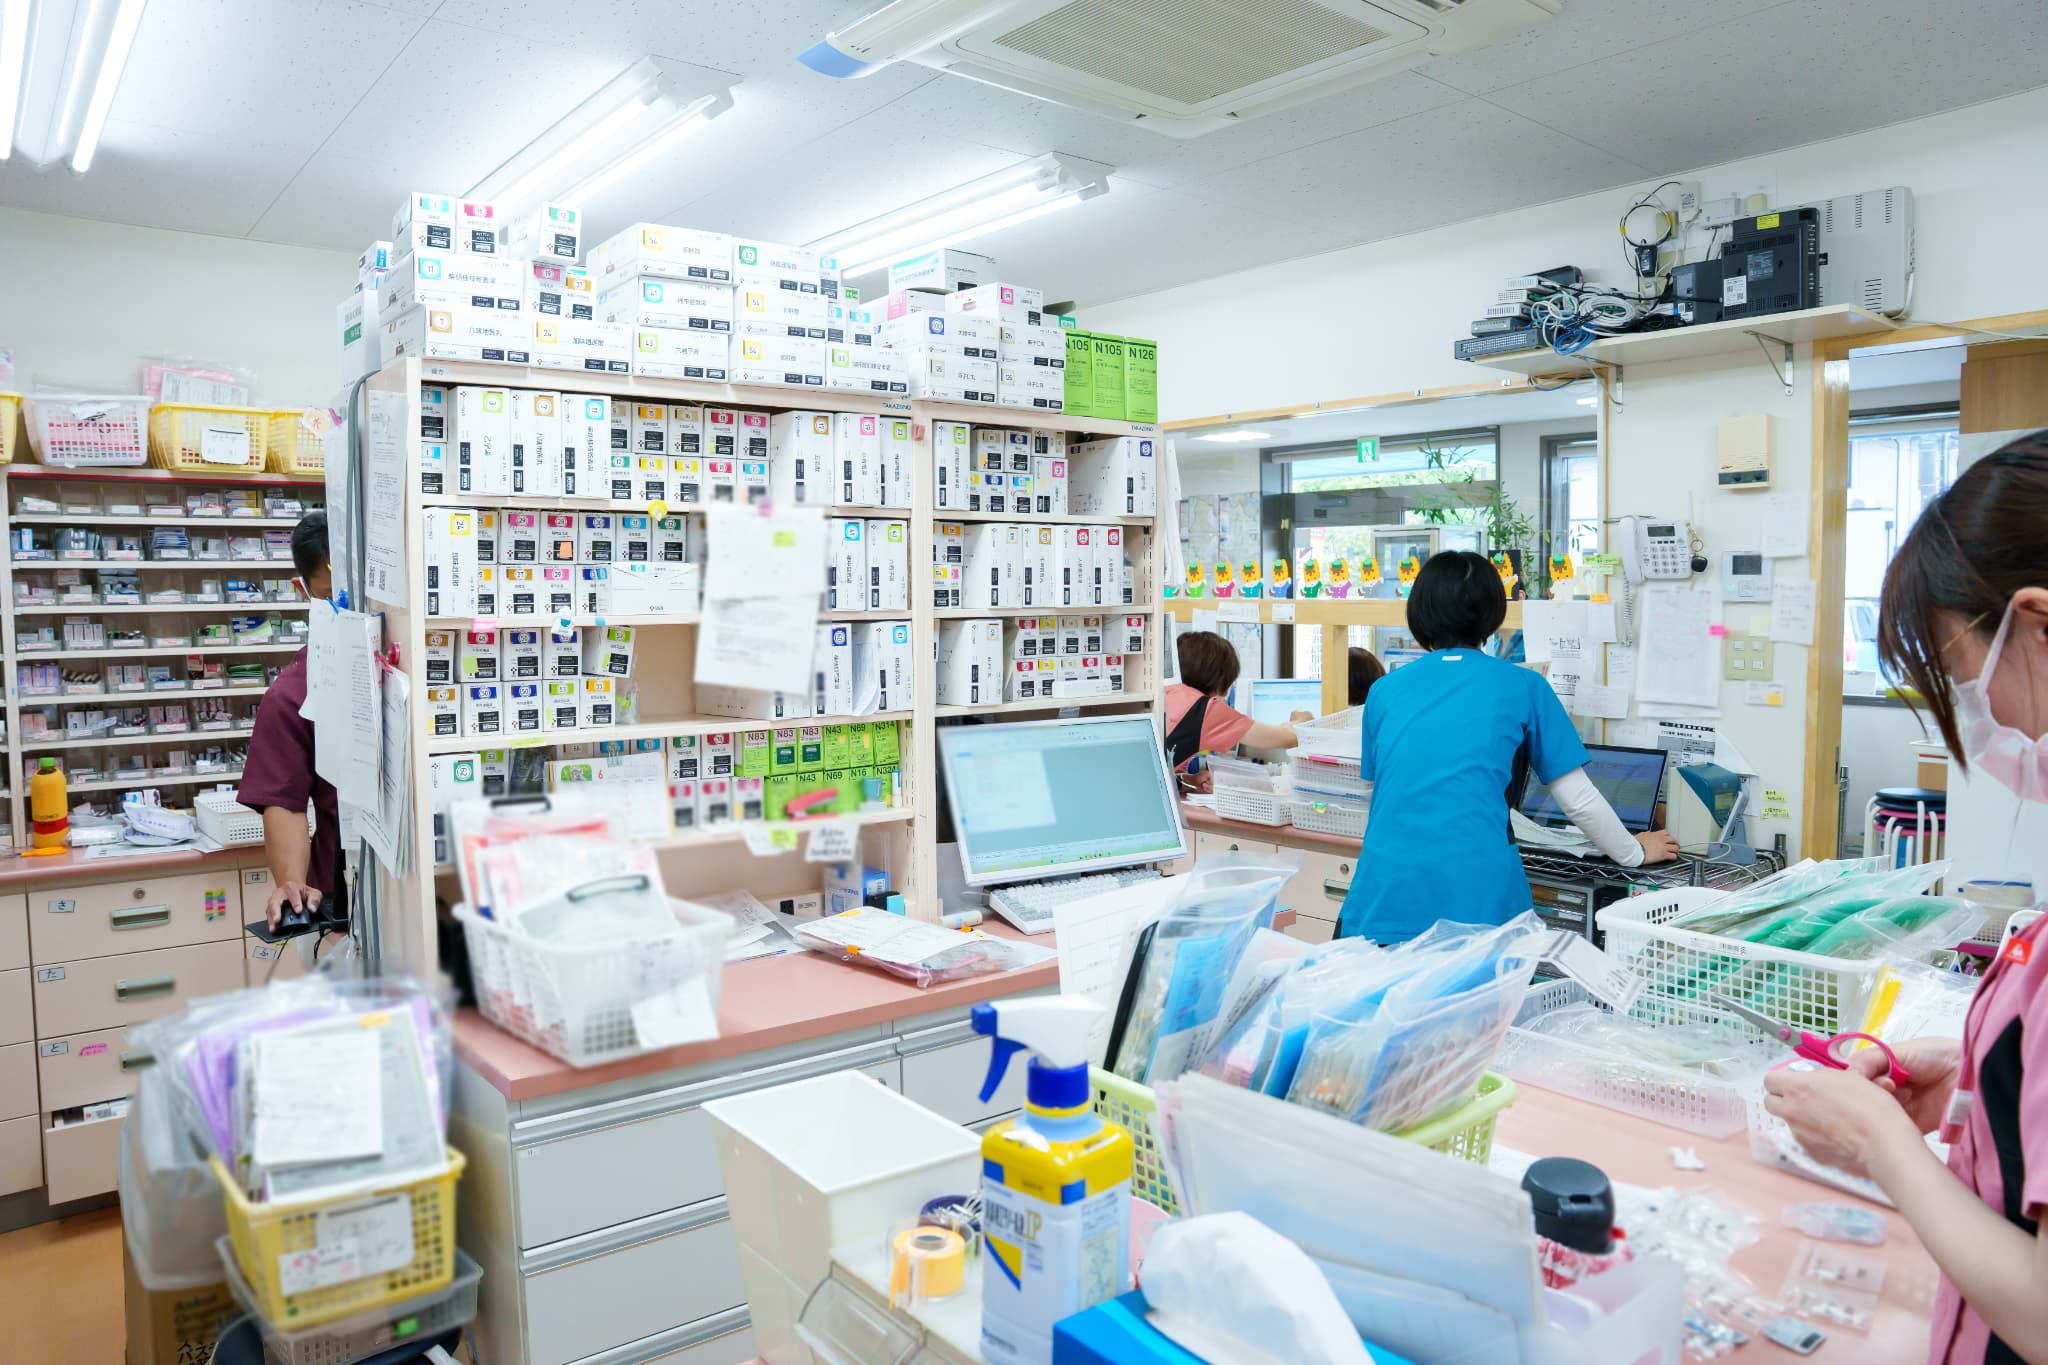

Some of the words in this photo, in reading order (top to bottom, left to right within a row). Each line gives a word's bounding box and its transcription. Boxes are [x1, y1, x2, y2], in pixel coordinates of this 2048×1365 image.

[1095, 342, 1122, 356] N105
[1128, 348, 1154, 361] N126
[802, 727, 819, 736] N83
[825, 725, 842, 734] N43
[850, 723, 866, 732] N69
[748, 732, 765, 740] N83
[777, 729, 794, 737] N83
[826, 771, 843, 780] N69
[850, 768, 867, 776] N16
[799, 774, 816, 782] N43
